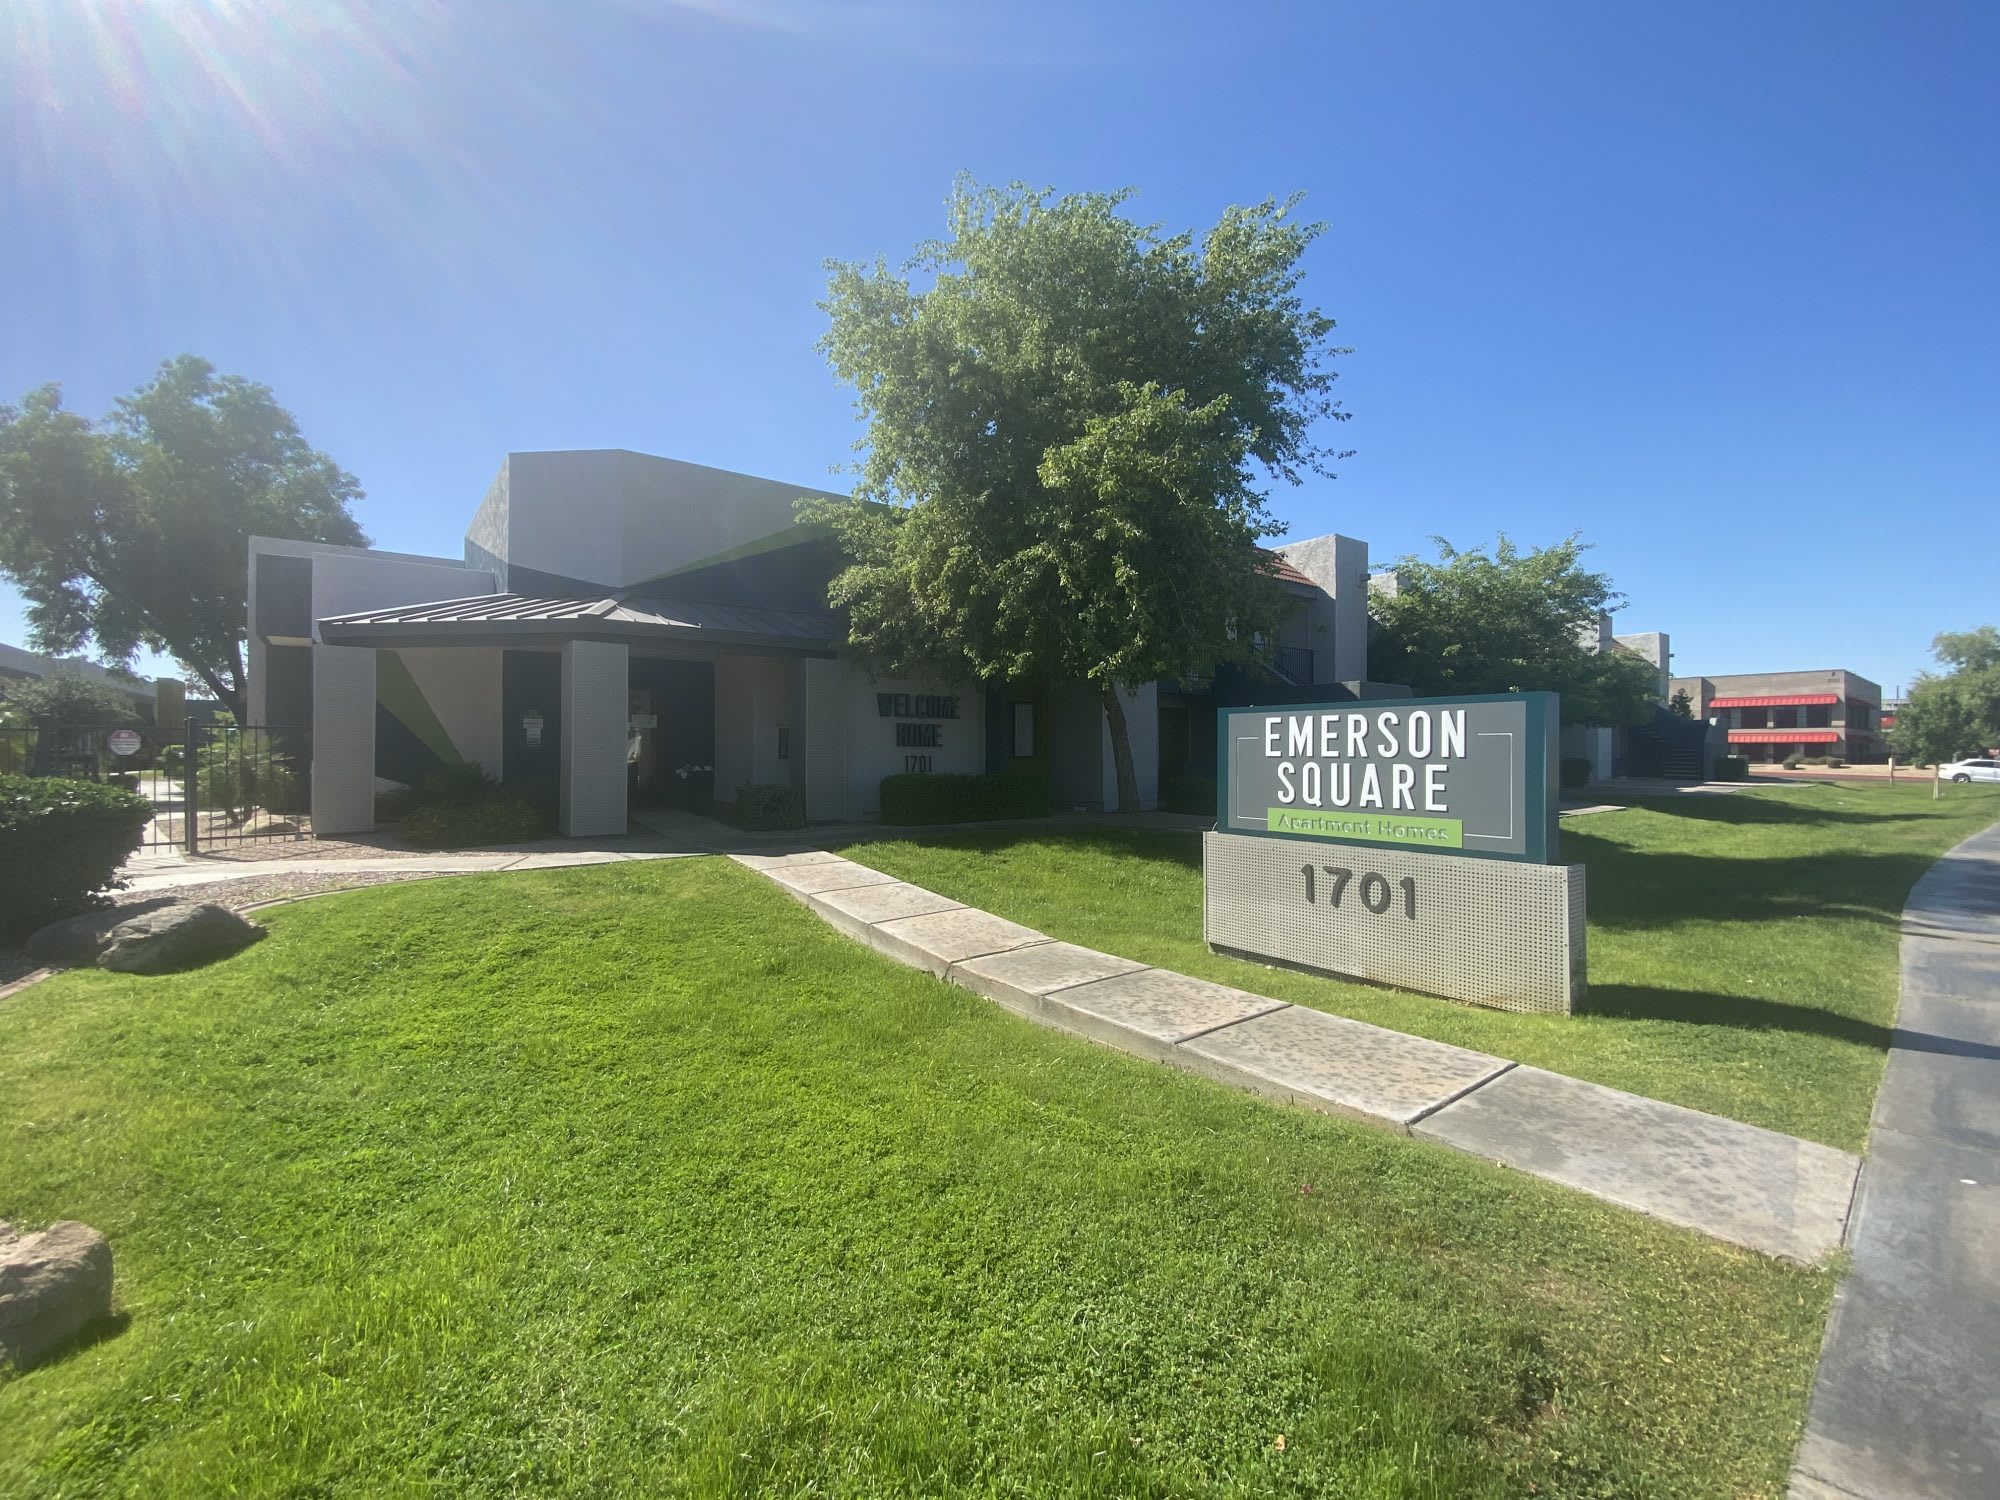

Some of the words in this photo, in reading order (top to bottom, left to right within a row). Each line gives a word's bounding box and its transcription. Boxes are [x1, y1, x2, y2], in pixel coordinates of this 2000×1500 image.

[877, 693, 960, 719] WELCOME
[896, 723, 943, 747] HOME
[1265, 709, 1467, 759] EMERSON
[905, 755, 932, 773] 1701
[1277, 761, 1450, 812] SQUARE
[1279, 813, 1371, 835] Apartment
[1378, 821, 1449, 841] Homes
[1302, 864, 1416, 921] 1701
